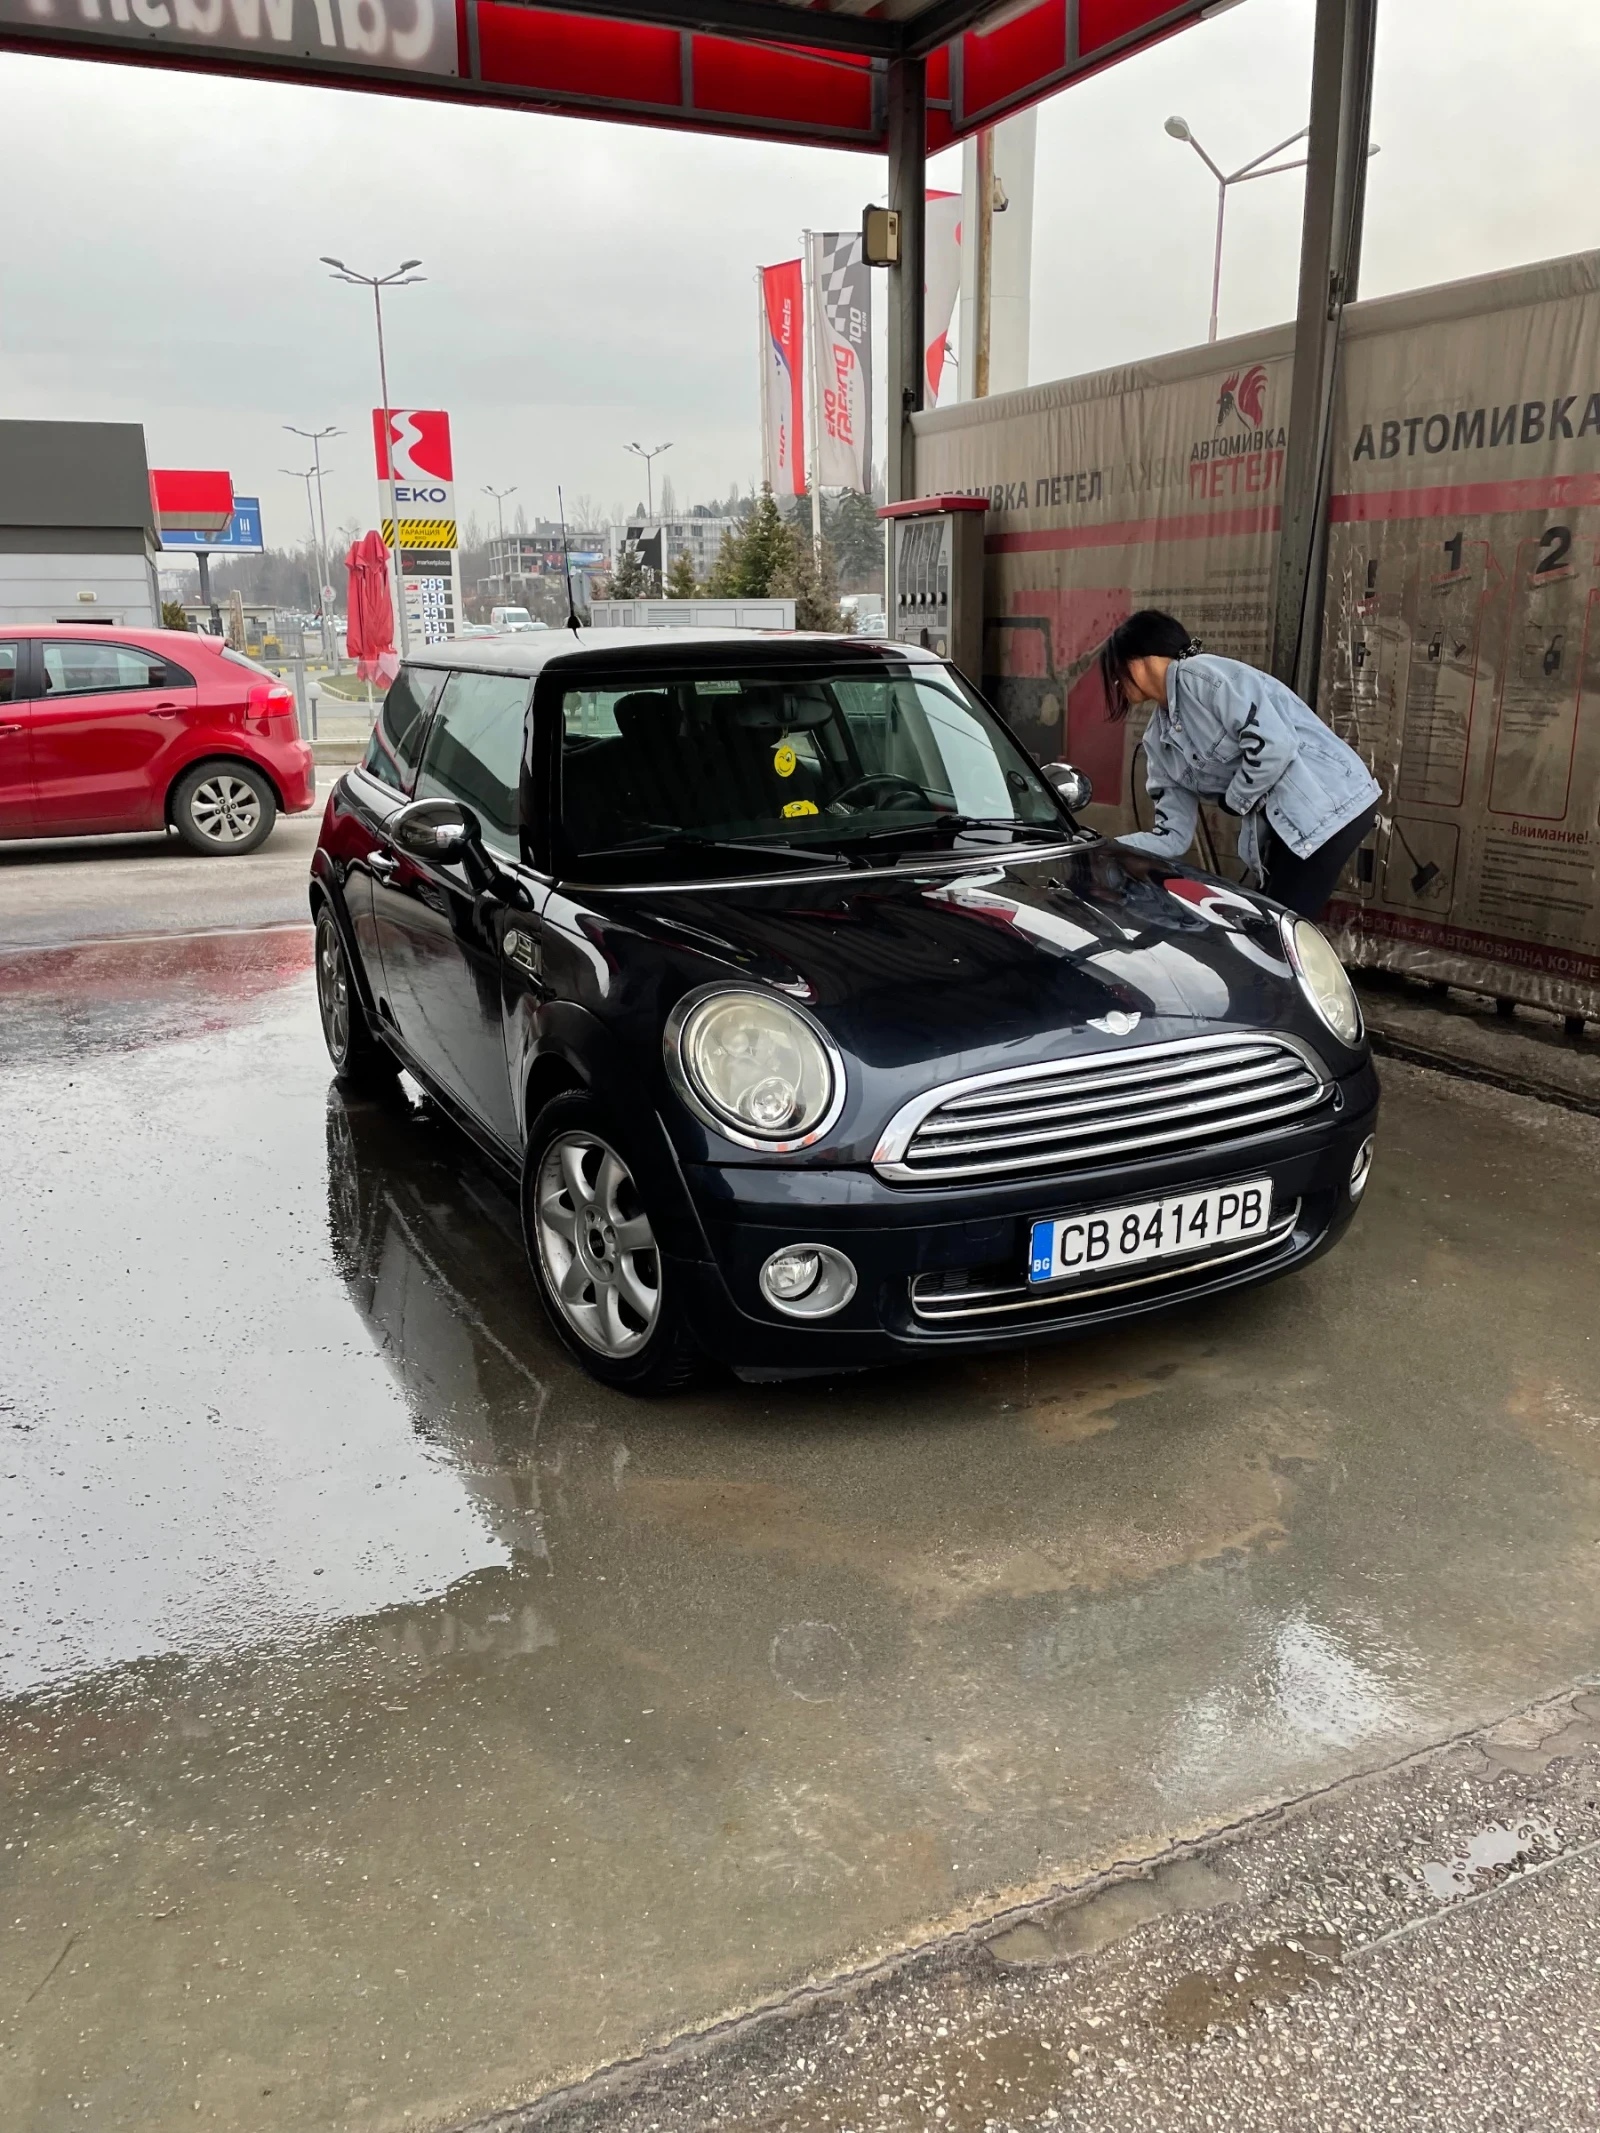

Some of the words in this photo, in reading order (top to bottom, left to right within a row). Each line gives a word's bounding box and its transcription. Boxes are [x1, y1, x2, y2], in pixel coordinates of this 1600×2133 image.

[781, 298, 792, 345] fuels
[849, 307, 862, 344] 100
[1352, 393, 1600, 462] АВТОМИВКА
[1190, 426, 1286, 462] АВТОМИВКА
[1035, 471, 1102, 508] ПЕТЕЛ
[1189, 449, 1285, 501] ПЕТЕЛ
[395, 487, 447, 503] EKO
[401, 528, 440, 536] ГАРАНЦИЯ
[416, 559, 451, 567] marketplace
[1444, 531, 1464, 573] 1
[1535, 526, 1572, 575] 2
[421, 578, 444, 591] 2.89
[422, 593, 446, 605] 3.30
[423, 607, 447, 620] 2.97
[425, 621, 448, 634] 3.34
[1511, 821, 1589, 846] Внимание!
[1437, 930, 1544, 966] АВТОМОБИЛНА
[1059, 1219, 1111, 1267] CB
[1119, 1199, 1209, 1254] 8414
[1216, 1188, 1262, 1235] PB
[1033, 1257, 1051, 1273] BG
